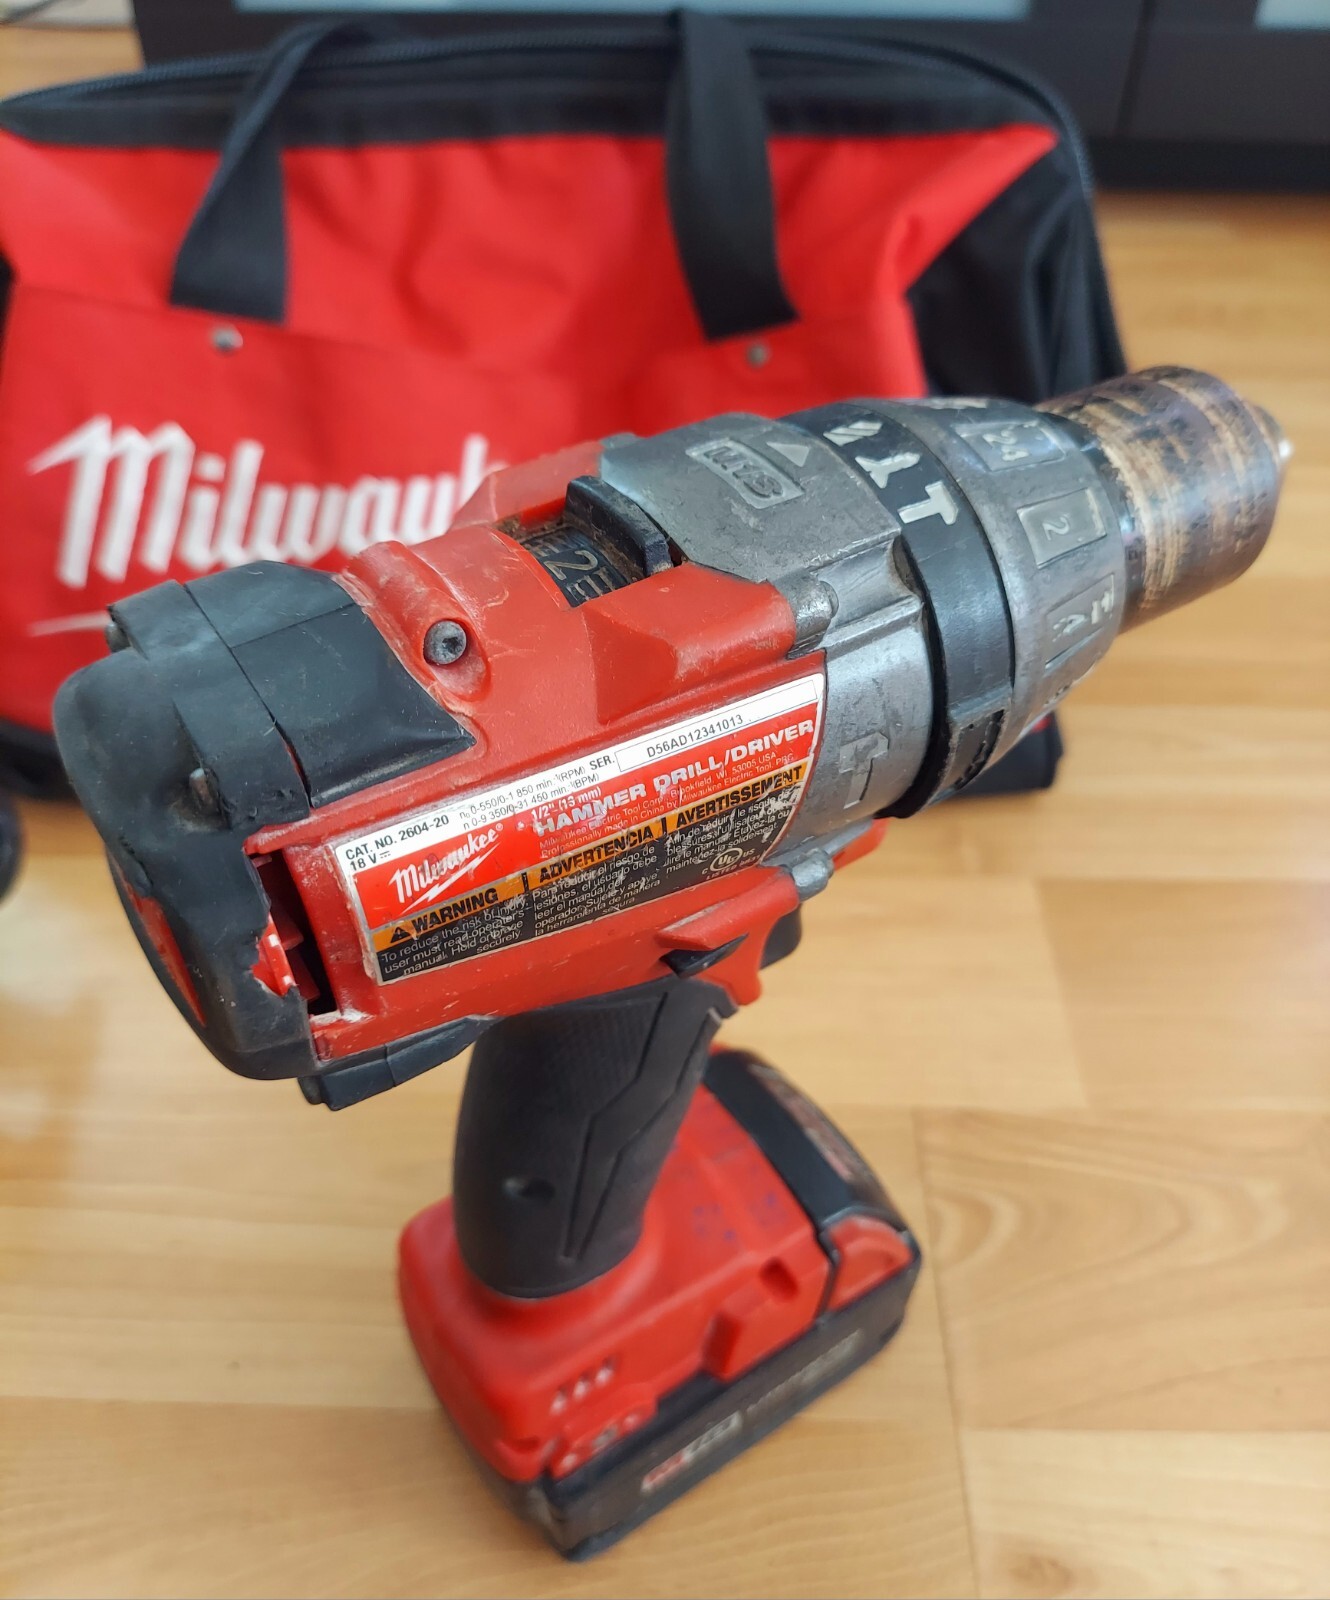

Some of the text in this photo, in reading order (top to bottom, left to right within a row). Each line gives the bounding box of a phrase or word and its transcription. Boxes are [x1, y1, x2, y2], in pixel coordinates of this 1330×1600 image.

[1042, 514, 1071, 540] 2
[544, 550, 599, 581] 2
[646, 713, 743, 758] D56AD12341013
[469, 791, 514, 815] 0-550/0-1
[515, 783, 534, 798] 850
[588, 753, 614, 771] SER.
[536, 718, 813, 837] HAMMER DRILL/DRIVER
[577, 785, 601, 804] mm)
[623, 802, 640, 816] Tool
[758, 750, 776, 764] USA
[674, 764, 802, 828] AVERTISSEMENT
[462, 821, 470, 830] n
[470, 813, 487, 827] 0-9
[530, 790, 548, 805] 450
[640, 803, 664, 819] China
[687, 825, 699, 838] de
[736, 806, 745, 817] le
[345, 813, 449, 861] CAT. NO. 2604-20
[538, 824, 652, 883] ADVERTENCIA
[682, 848, 691, 859] le
[777, 808, 790, 820] ou
[349, 852, 378, 872] 18 V
[581, 880, 591, 892] el
[632, 853, 656, 871] debe
[597, 862, 607, 874] el
[642, 842, 654, 857] de
[411, 886, 498, 934] WARNING
[534, 904, 554, 920] leer
[556, 900, 565, 911] el
[620, 886, 625, 894] y
[534, 926, 543, 936] la
[608, 894, 621, 905] de
[382, 949, 396, 963] To
[398, 933, 439, 957] reduce
[441, 923, 459, 939] the
[461, 914, 481, 930] risk
[384, 956, 410, 974] user
[412, 942, 440, 961] must
[443, 930, 468, 949] read
